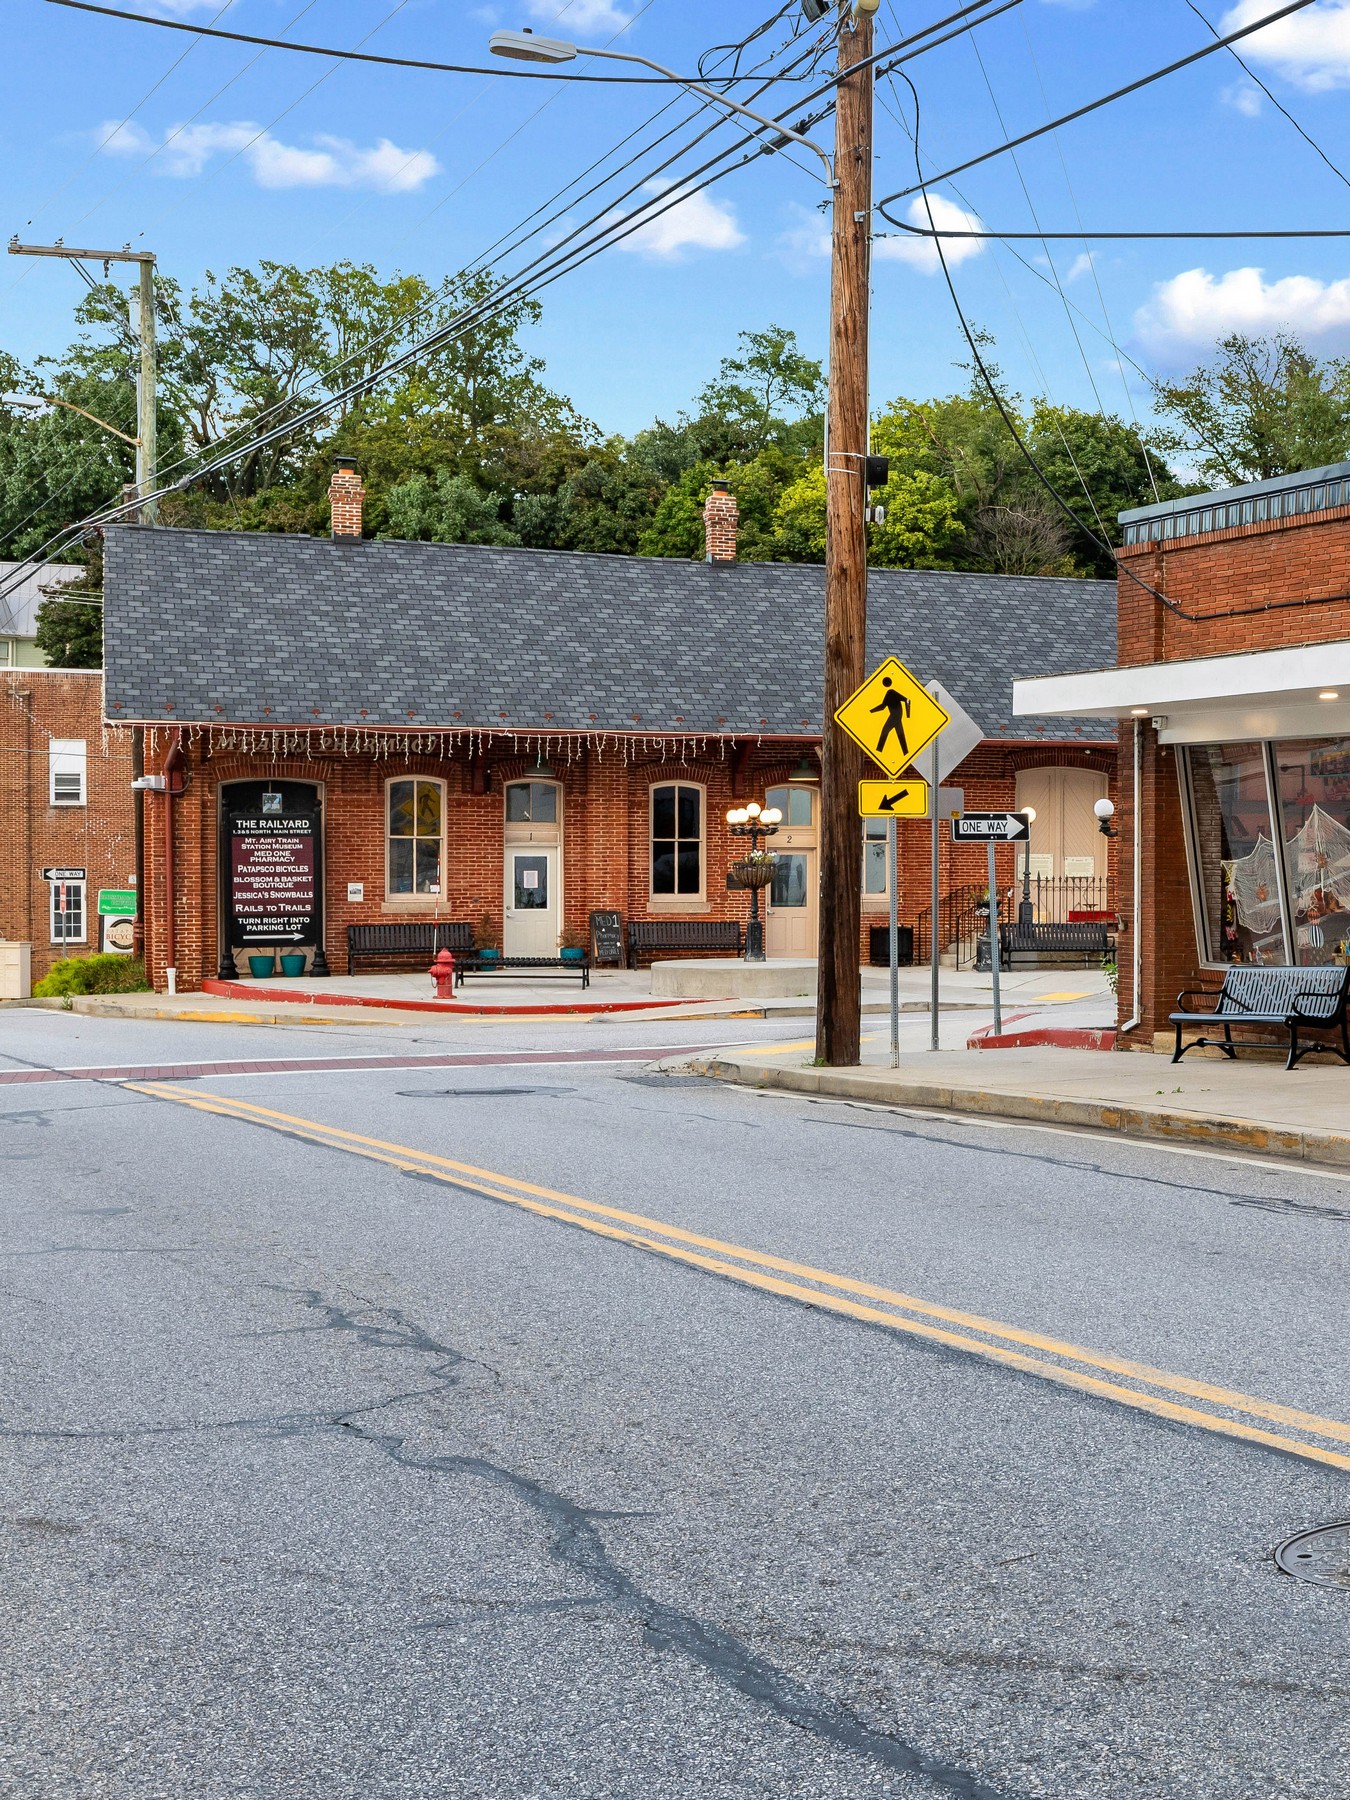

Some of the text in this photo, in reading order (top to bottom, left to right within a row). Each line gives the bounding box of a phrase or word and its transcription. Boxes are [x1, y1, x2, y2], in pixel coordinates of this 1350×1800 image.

[236, 820, 310, 829] THE RAILYARD
[962, 821, 1008, 833] ONE WAY
[786, 834, 793, 844] 2
[237, 864, 309, 873] PATAPSCO BICYCLES
[269, 890, 314, 899] SNOWBALLS
[235, 903, 264, 912] RAILS
[278, 903, 312, 912] TRAILS
[237, 917, 261, 925] TURN
[290, 916, 310, 924] INTO
[246, 924, 284, 932] PARKING
